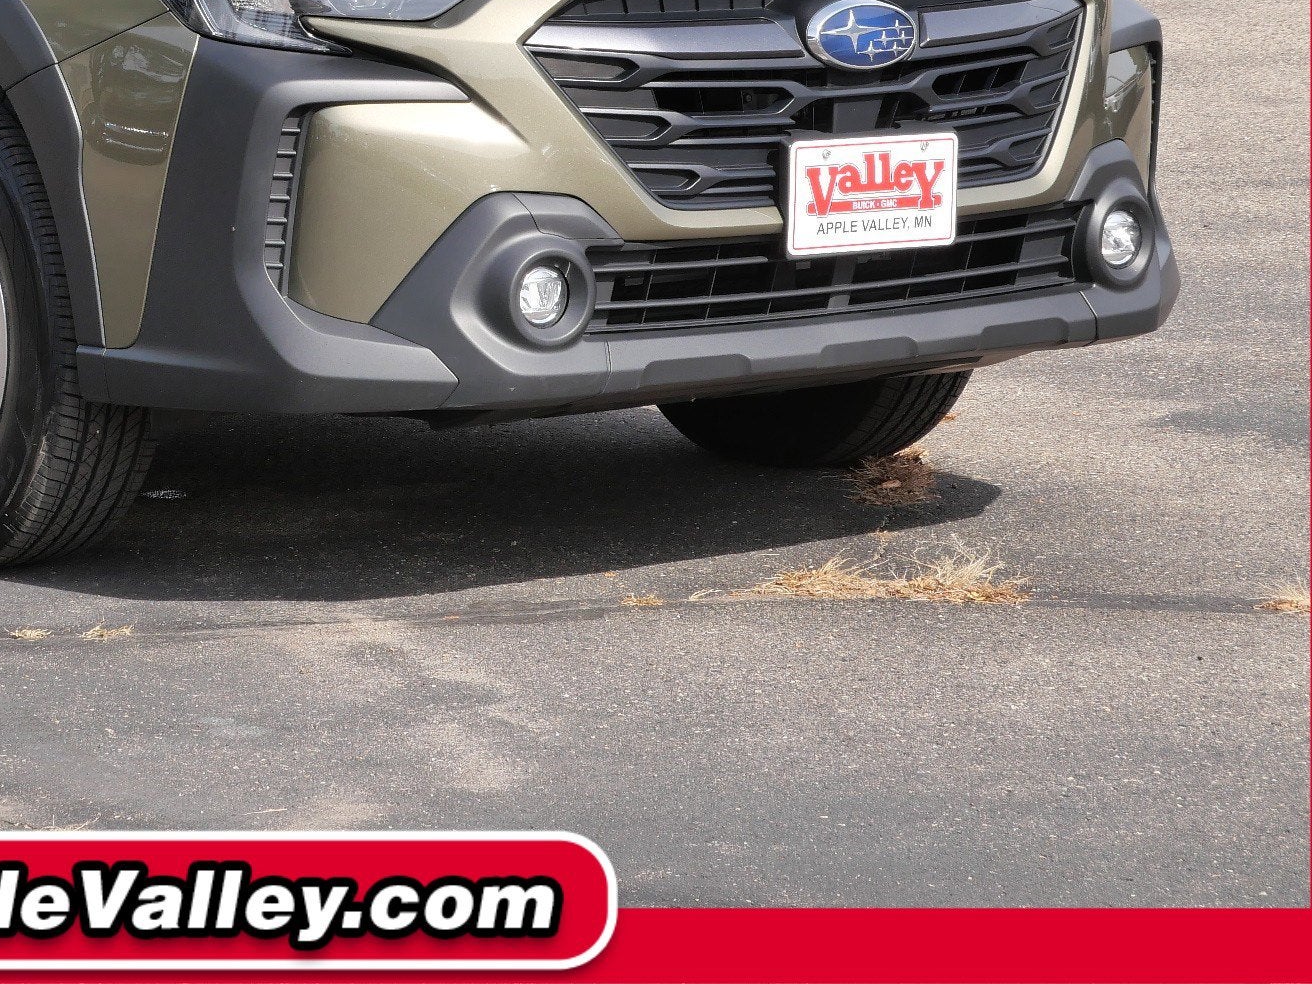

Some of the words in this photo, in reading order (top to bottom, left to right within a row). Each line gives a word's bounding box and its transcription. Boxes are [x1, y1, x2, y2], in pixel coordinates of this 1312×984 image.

[805, 151, 945, 217] Valley
[852, 200, 876, 211] BUICK
[880, 199, 898, 209] GMC
[816, 220, 858, 235] APPLE
[862, 217, 910, 232] VALLEY,
[914, 215, 933, 229] MN
